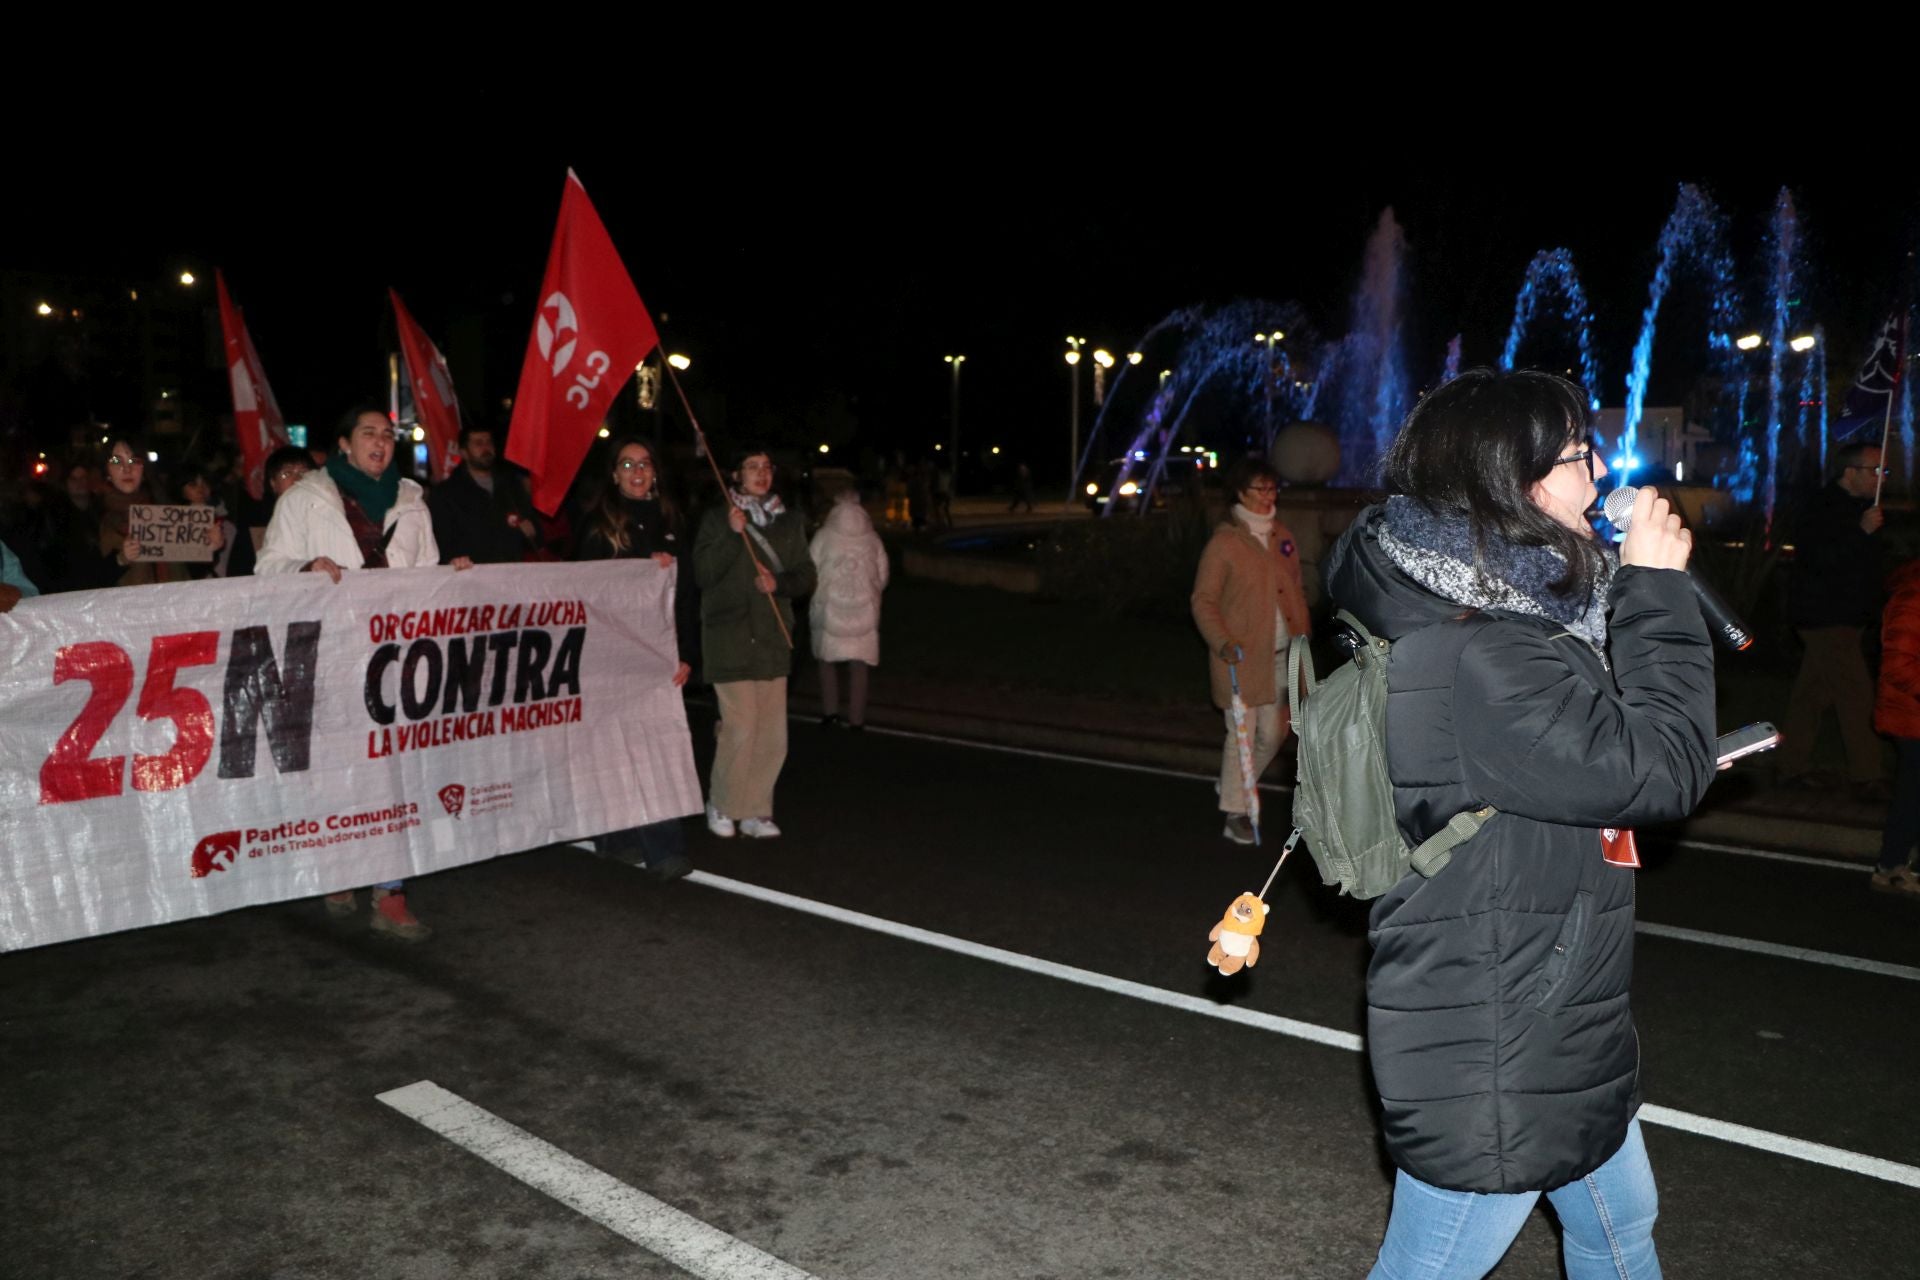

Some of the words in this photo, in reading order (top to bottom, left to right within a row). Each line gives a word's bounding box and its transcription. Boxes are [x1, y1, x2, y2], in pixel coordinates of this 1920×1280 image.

[132, 507, 153, 521] NO
[160, 507, 212, 524] SOMOS
[370, 605, 496, 644] ORGANIZAR
[497, 604, 523, 629] LA
[526, 600, 588, 627] LUCHA
[364, 626, 587, 726] CONTRA
[38, 620, 321, 805] 25N
[367, 729, 393, 759] LA
[397, 711, 496, 752] VIOLENCIA
[501, 697, 582, 734] MACHISTA
[246, 819, 320, 844] Partido
[326, 802, 418, 830] Comunista
[248, 847, 264, 858] de
[267, 844, 286, 855] los
[288, 829, 367, 850] Trabajadores
[369, 826, 384, 836] de
